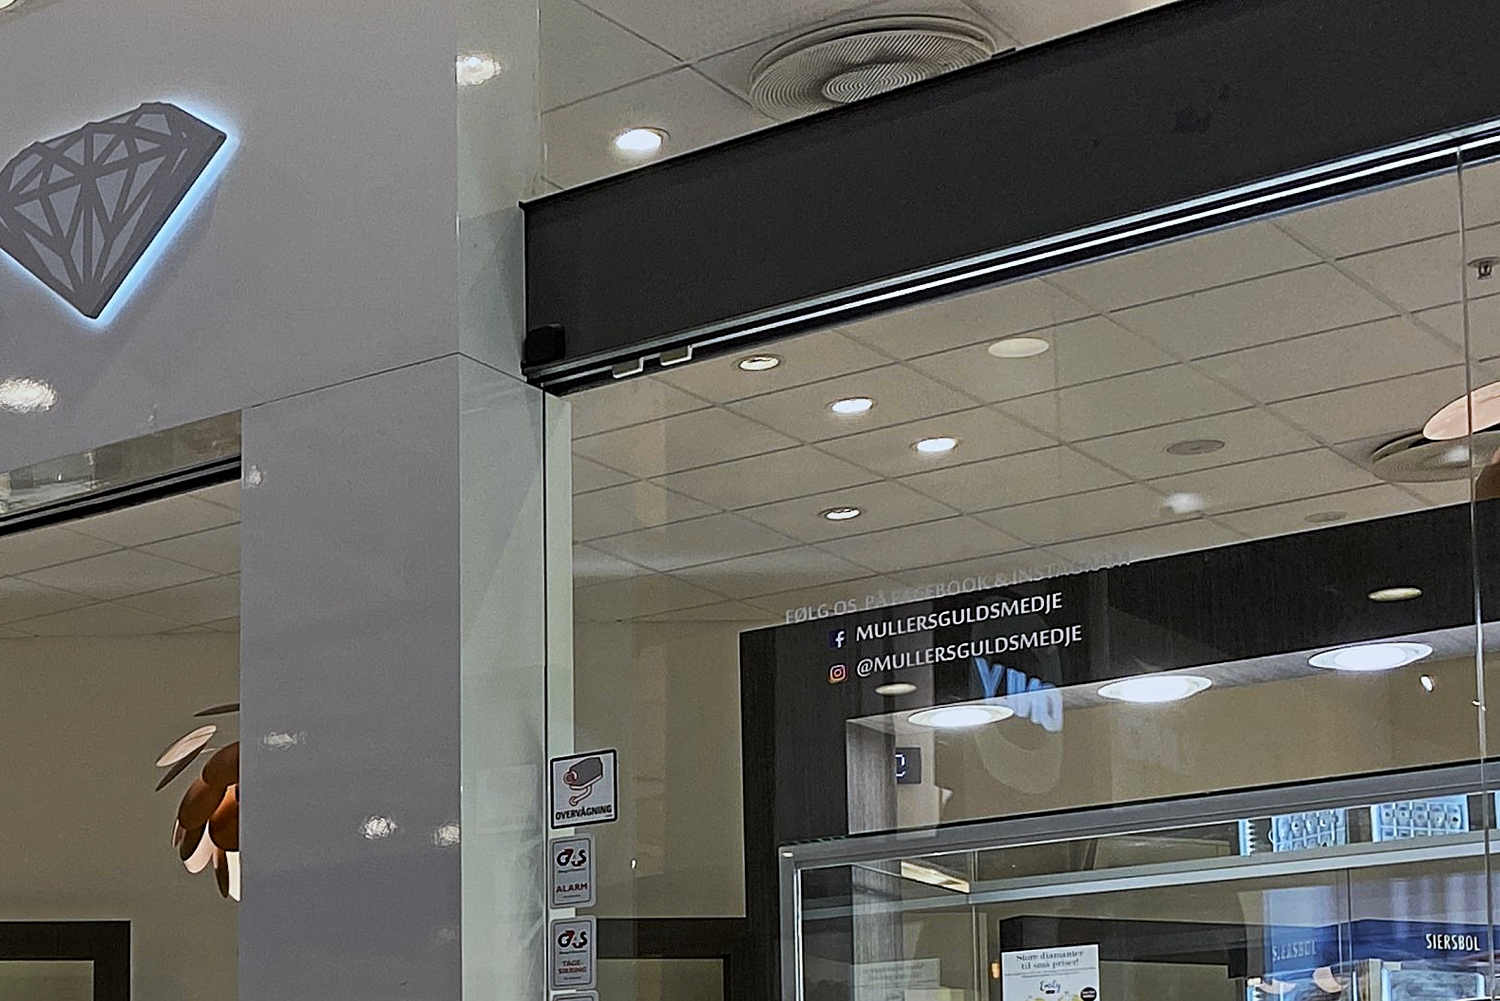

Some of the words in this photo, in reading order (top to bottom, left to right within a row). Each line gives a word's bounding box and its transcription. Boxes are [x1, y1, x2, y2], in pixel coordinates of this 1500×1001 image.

[785, 602, 829, 625] FØLG
[834, 598, 859, 615] OS
[855, 592, 1063, 642] MULLERSGULDSMEDJE
[856, 624, 1083, 678] @MULLERSGULDSMEDJE
[555, 804, 613, 821] OVERVÅGNING
[555, 882, 588, 894] ALARM
[1425, 932, 1482, 952] SIERSBOL
